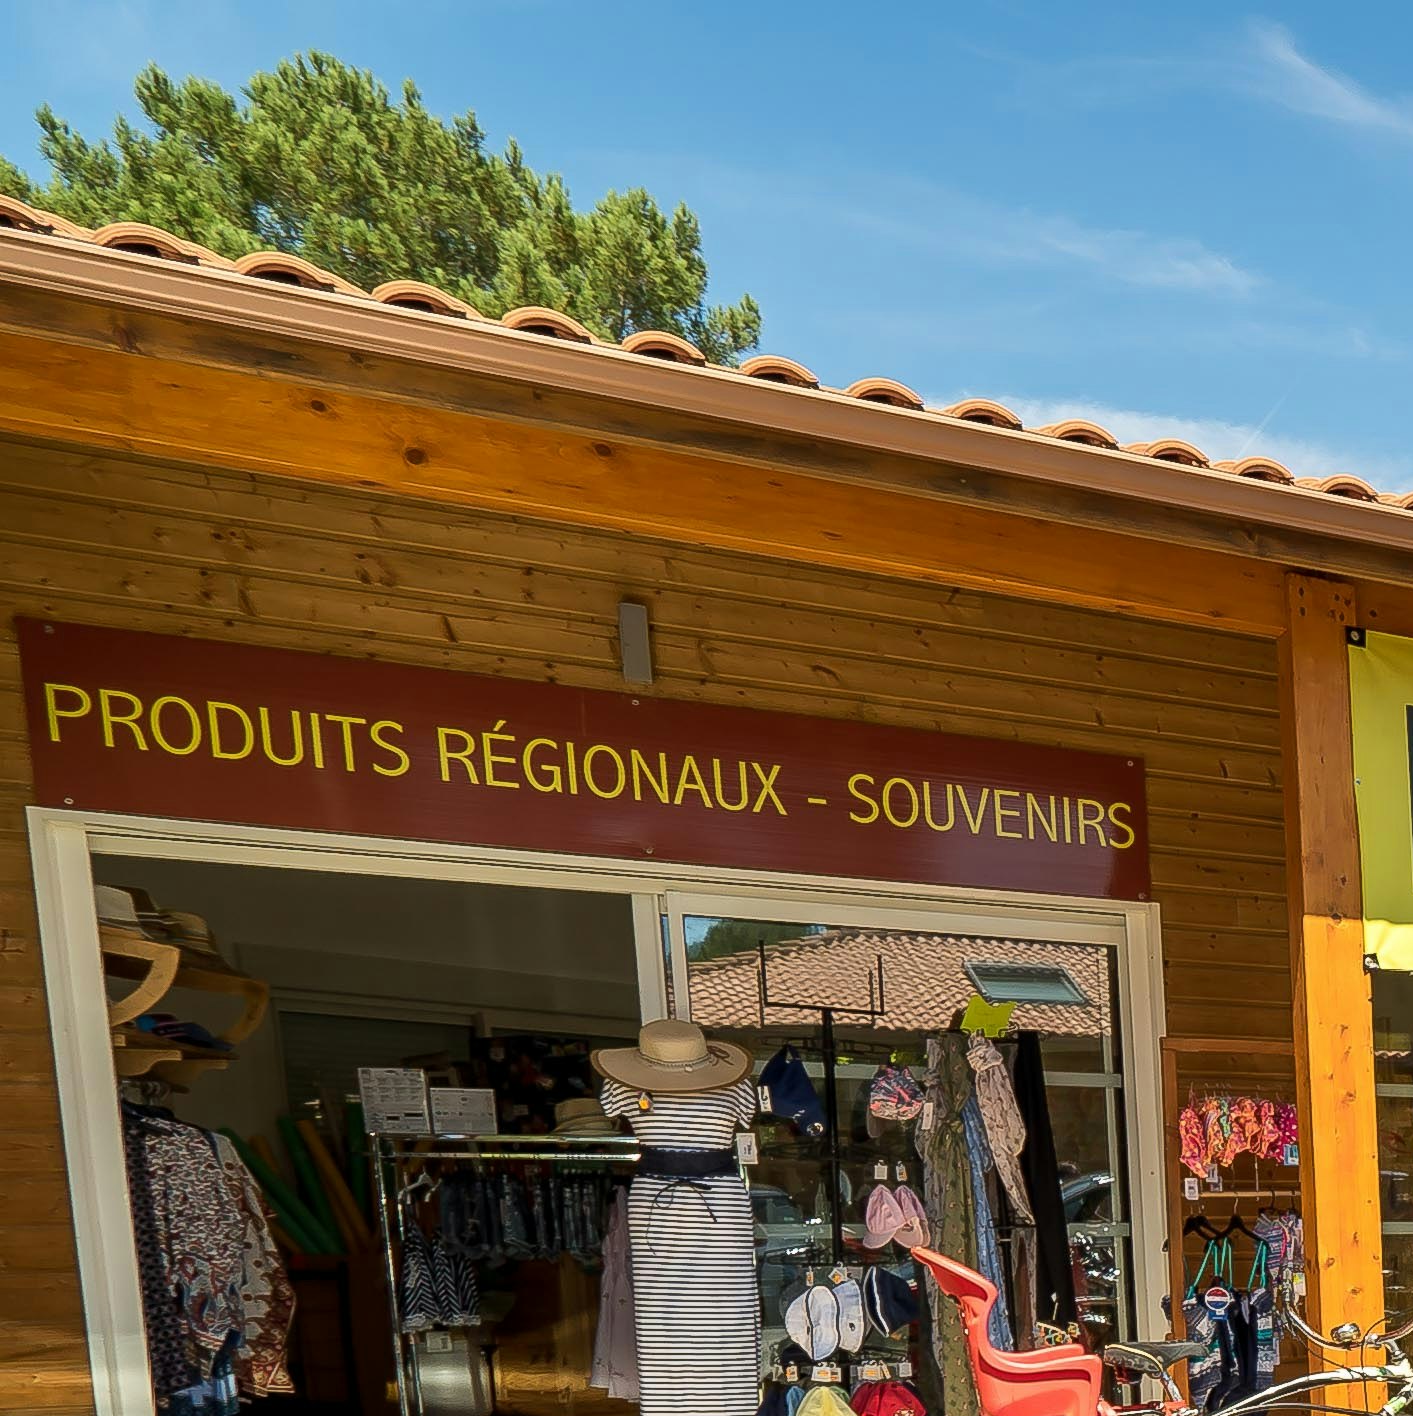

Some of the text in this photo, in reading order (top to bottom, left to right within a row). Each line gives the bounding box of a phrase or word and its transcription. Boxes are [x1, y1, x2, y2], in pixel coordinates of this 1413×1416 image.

[43, 681, 411, 778] PRODUITS
[438, 719, 788, 817] RÉGIONAUX
[848, 773, 1137, 851] SOUVENIRS
